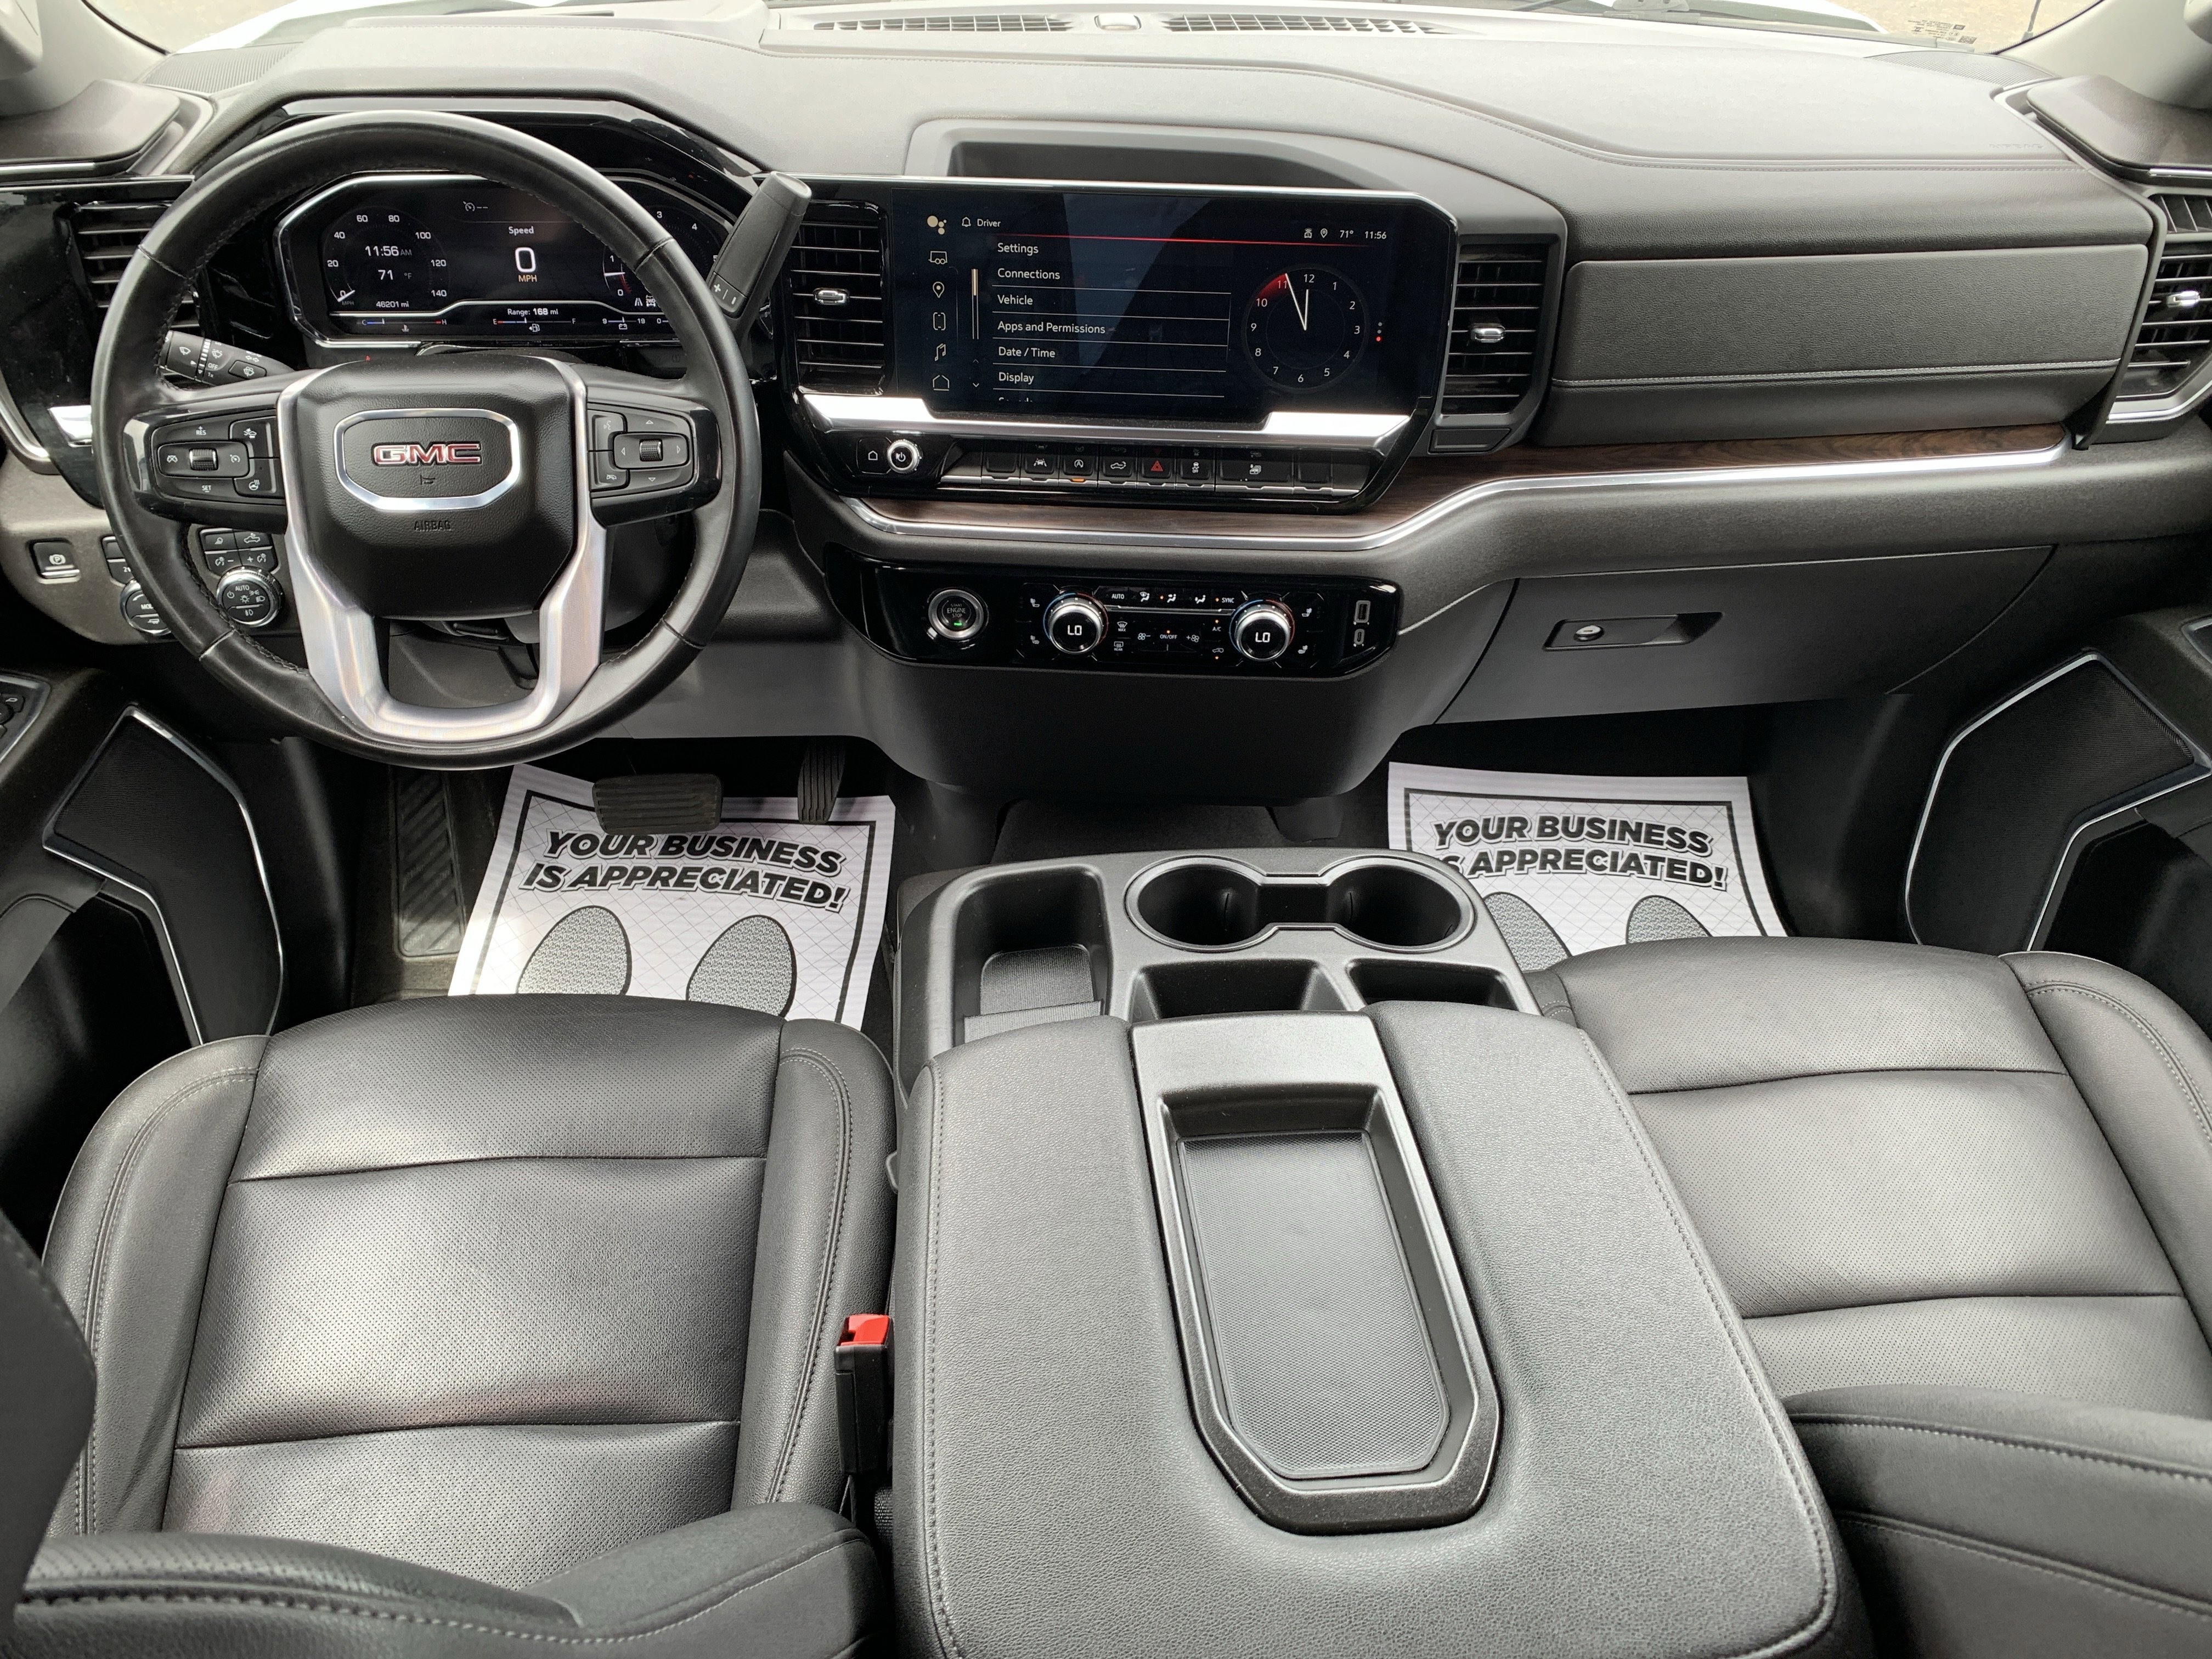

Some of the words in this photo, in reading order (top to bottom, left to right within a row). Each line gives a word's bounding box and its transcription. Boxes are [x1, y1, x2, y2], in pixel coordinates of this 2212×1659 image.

[509, 226, 534, 235] Speed
[365, 246, 399, 256] 11:56
[998, 243, 1039, 256] Settings
[515, 247, 535, 272] 0
[378, 270, 393, 280] 71
[998, 268, 1060, 279] Connections
[1304, 274, 1314, 283] 12
[1277, 280, 1288, 289] 11
[1333, 282, 1336, 290] 1
[997, 295, 1032, 304] Vehicle
[1257, 298, 1267, 307] 10
[1350, 301, 1355, 309] 2
[998, 321, 1023, 332] Apps
[1025, 322, 1043, 331] and
[1047, 323, 1105, 334] Permissions
[999, 347, 1022, 356] Date
[1024, 348, 1029, 356] /
[1031, 348, 1055, 357] Time
[1255, 348, 1261, 356] 8
[1324, 368, 1329, 376] 5
[999, 372, 1034, 385] Display
[1298, 374, 1304, 382] 6
[374, 443, 481, 465] GMC
[414, 520, 453, 532] AIRBAG
[1433, 815, 1531, 848] YOUR
[1535, 816, 1713, 856] BUSINESS
[548, 830, 656, 857] YOUR
[657, 833, 845, 876] BUSINESS
[1467, 849, 1726, 890] APPRECIATED!
[521, 863, 567, 891] IS
[563, 864, 849, 911] APPRECIATED!
